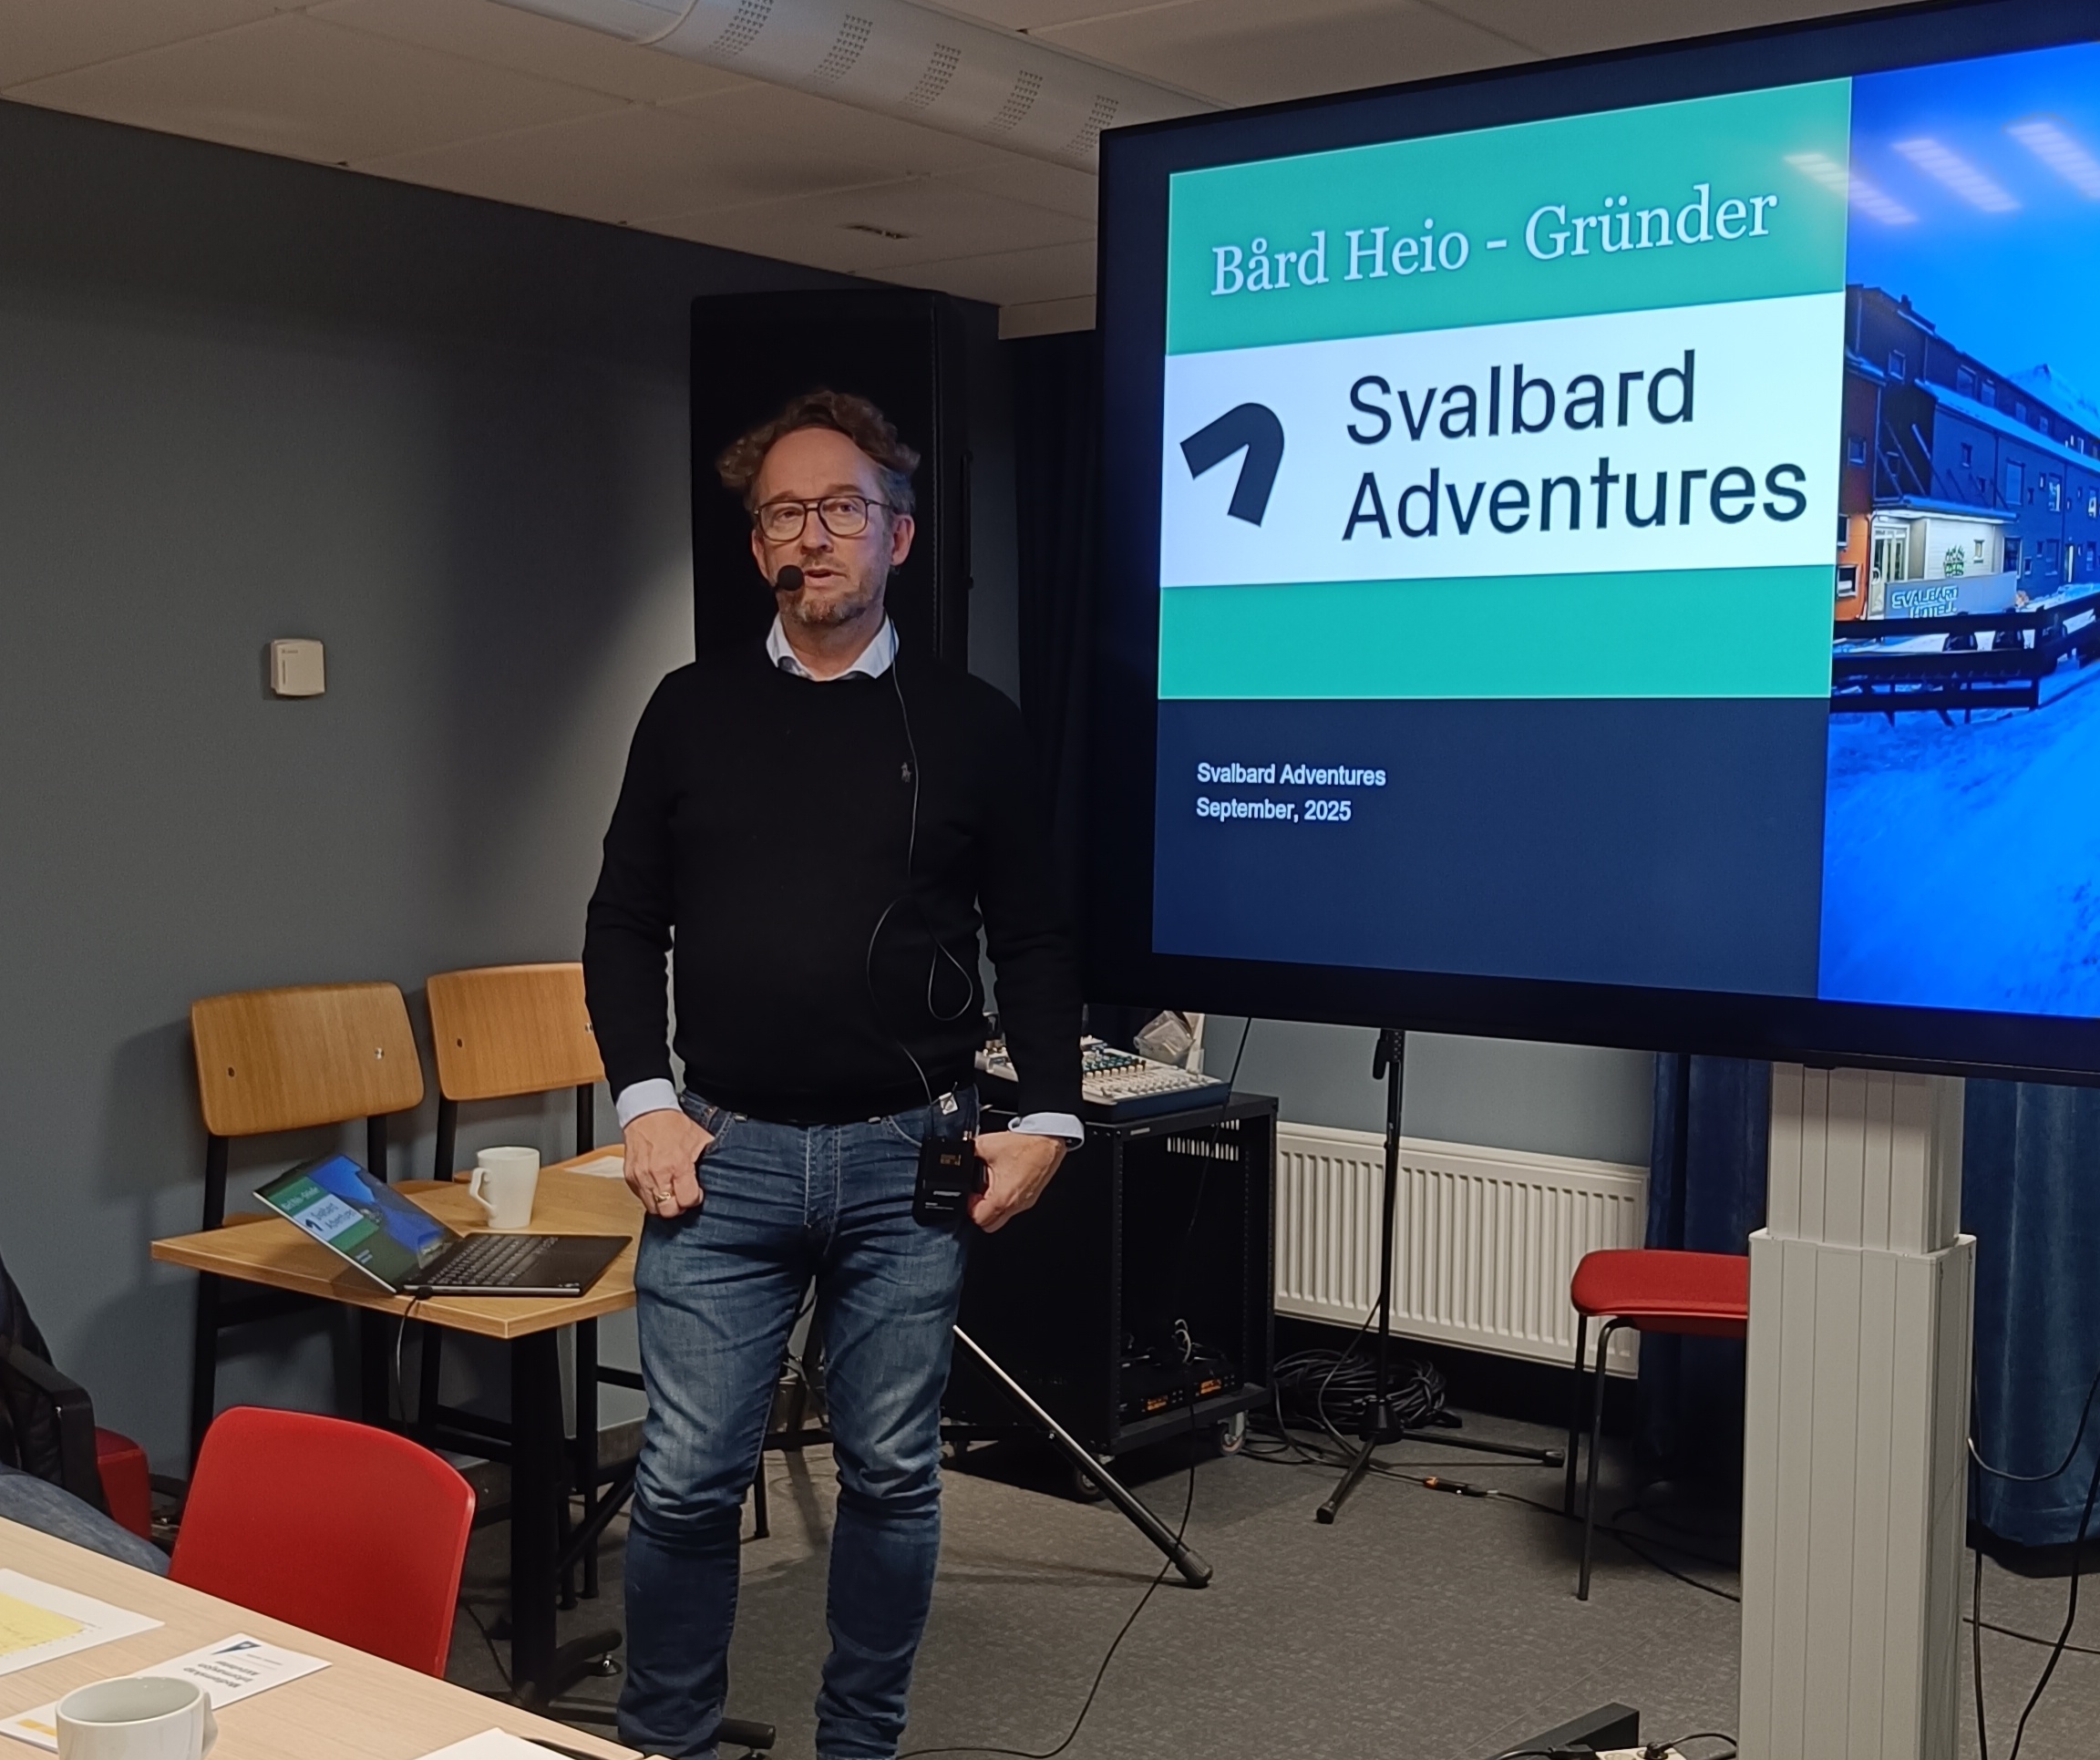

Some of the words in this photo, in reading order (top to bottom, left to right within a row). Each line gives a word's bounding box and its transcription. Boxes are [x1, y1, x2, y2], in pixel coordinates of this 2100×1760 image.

[1210, 230, 1329, 296] Bård
[1343, 218, 1469, 281] Heio
[1487, 239, 1507, 249] -
[1525, 182, 1778, 260] Gründer
[1346, 348, 1695, 446] Svalbard
[1342, 456, 1807, 541] Adventures
[1196, 797, 1299, 823] September,
[1303, 799, 1352, 821] 2025
[1197, 762, 1276, 784] Svalbard
[1279, 764, 1386, 787] Adventures
